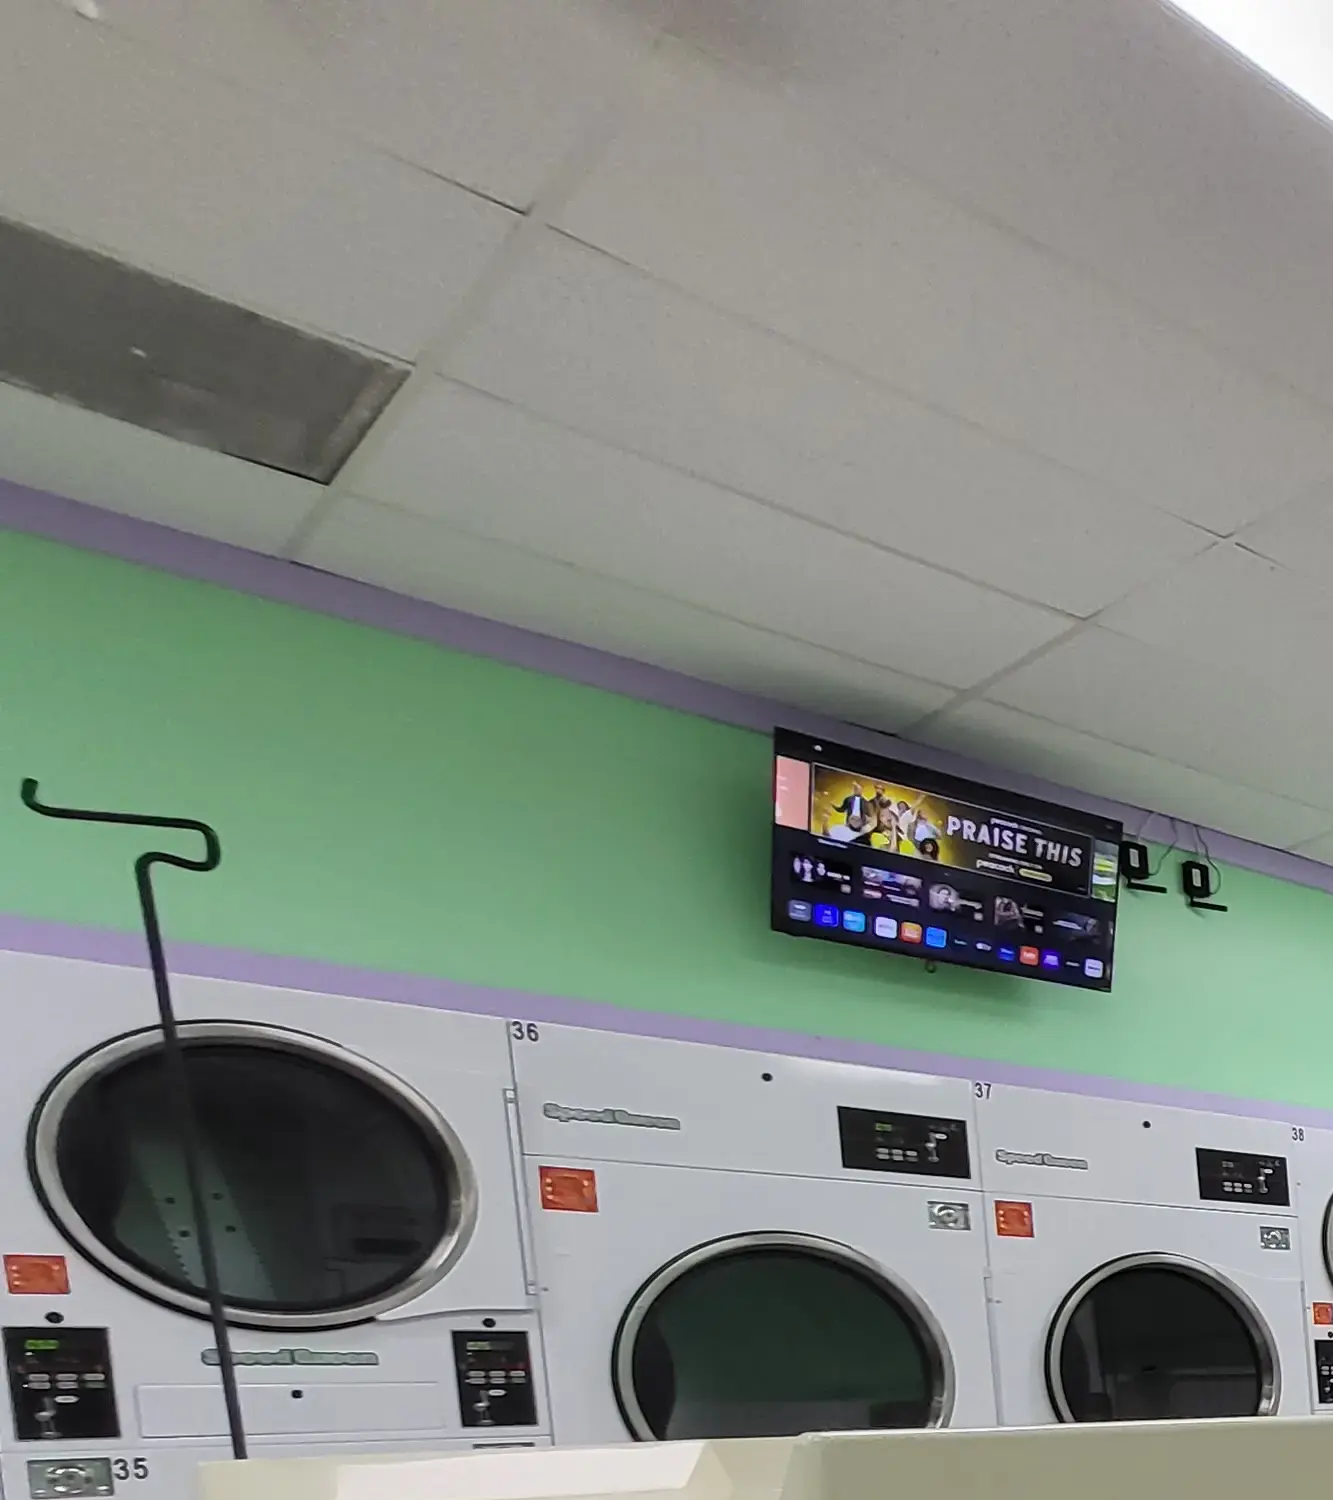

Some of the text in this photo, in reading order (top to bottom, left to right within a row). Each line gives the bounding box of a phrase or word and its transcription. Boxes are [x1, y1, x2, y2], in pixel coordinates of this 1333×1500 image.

[946, 815, 1028, 855] PRAISE
[1033, 837, 1083, 868] THIS
[511, 1020, 539, 1042] 36
[975, 1082, 992, 1100] 37
[1291, 1127, 1305, 1141] 38
[113, 1457, 149, 1480] 35
